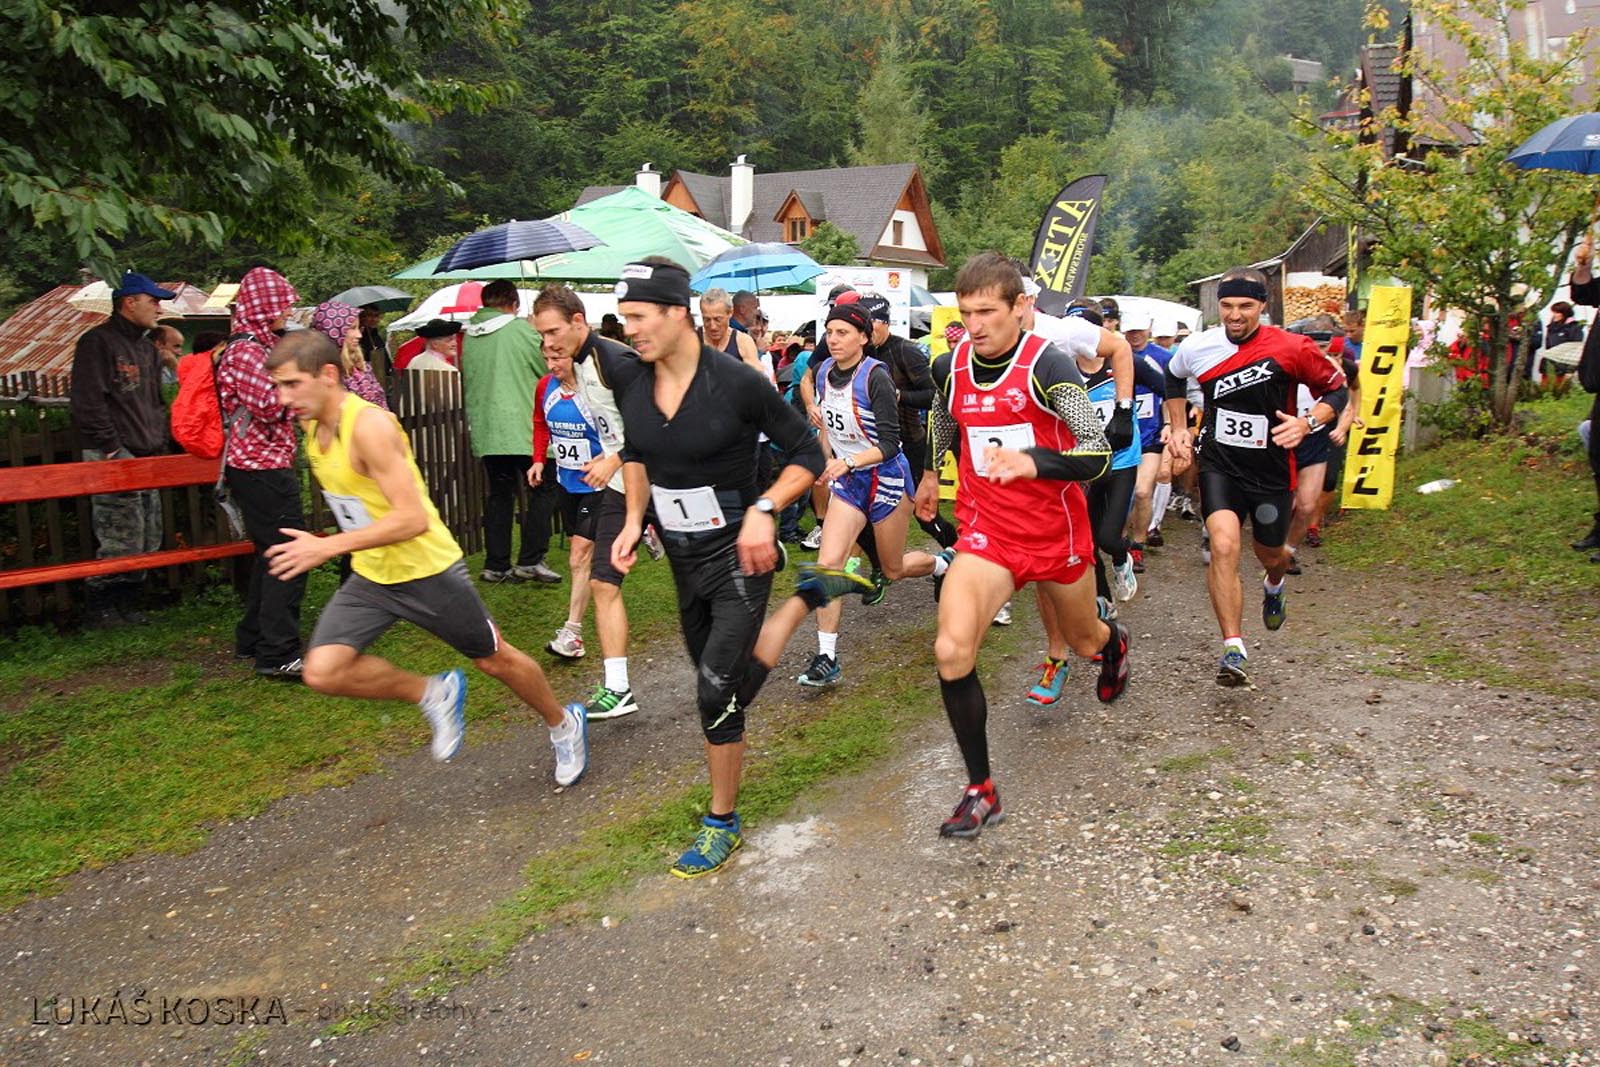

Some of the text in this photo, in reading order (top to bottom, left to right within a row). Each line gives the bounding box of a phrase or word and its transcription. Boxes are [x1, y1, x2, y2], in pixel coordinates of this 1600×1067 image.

[1213, 361, 1274, 399] ATEX
[826, 410, 845, 431] 35
[1224, 418, 1253, 438] 38
[557, 443, 580, 461] 94
[673, 498, 689, 519] 1
